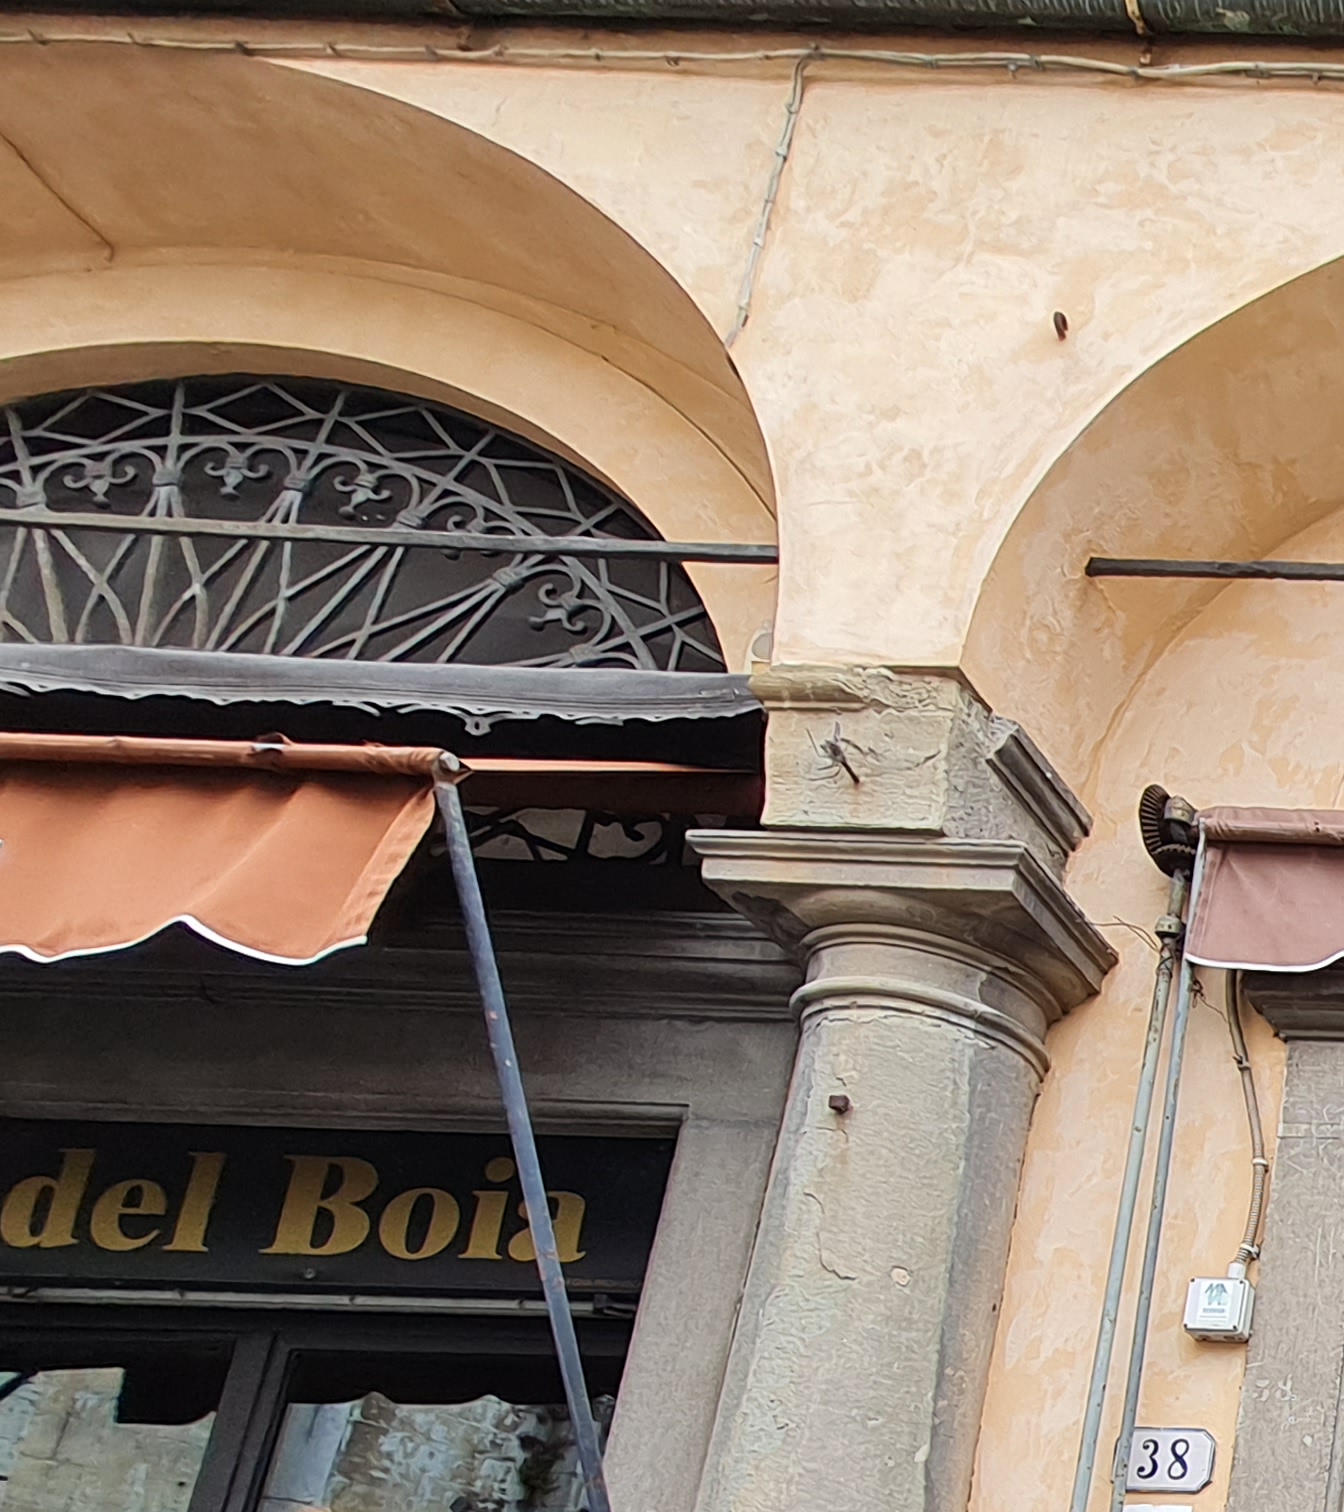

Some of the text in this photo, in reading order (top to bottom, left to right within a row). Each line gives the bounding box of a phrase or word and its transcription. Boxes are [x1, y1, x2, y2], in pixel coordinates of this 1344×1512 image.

[0, 1147, 588, 1264] del Boia
[1135, 1437, 1191, 1481] 38
